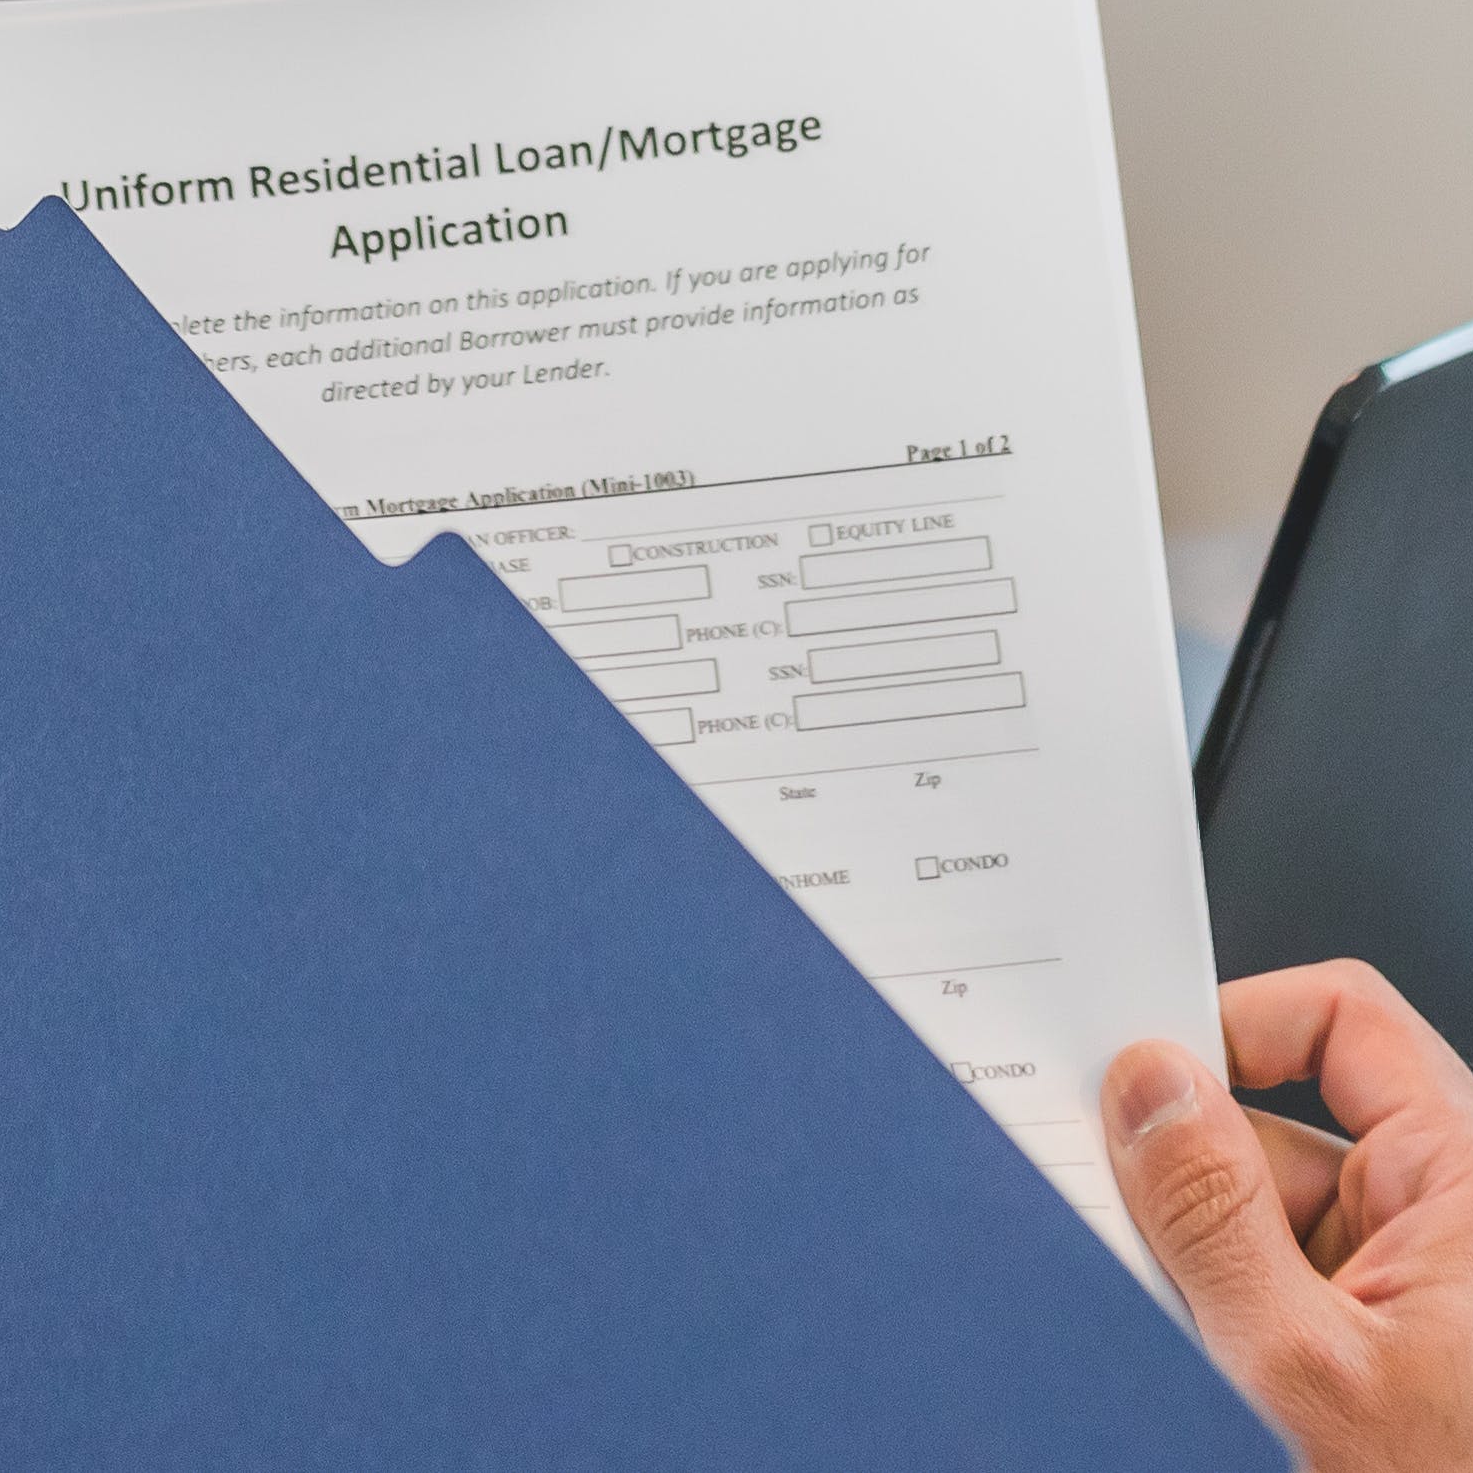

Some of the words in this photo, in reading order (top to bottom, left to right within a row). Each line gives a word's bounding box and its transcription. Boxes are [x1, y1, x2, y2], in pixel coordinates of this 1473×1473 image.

[61, 173, 234, 212] Uniform
[249, 143, 480, 198] Residential
[495, 114, 822, 175] Loan/Mortgage
[330, 207, 568, 263] Application
[171, 314, 225, 337] lete
[234, 309, 272, 332] the
[280, 294, 421, 332] information
[428, 294, 458, 316] on
[466, 285, 509, 311] this
[516, 275, 657, 314] application.
[666, 269, 688, 296] If
[688, 266, 732, 293] you
[739, 261, 777, 284] are
[785, 246, 888, 283] applying
[895, 242, 931, 271] for
[266, 344, 322, 369] each
[329, 332, 452, 365] additional
[459, 321, 569, 353] Borrower
[576, 314, 639, 340] must
[645, 304, 735, 337] provide
[742, 289, 886, 325] information
[893, 283, 921, 307] as
[320, 375, 420, 404] directed
[427, 372, 455, 398] by
[462, 367, 516, 394] your
[523, 357, 611, 386] Lender.
[906, 443, 952, 464] Page
[959, 439, 967, 457] 1
[974, 436, 994, 455] of
[999, 434, 1012, 454] 2
[366, 495, 458, 516] Mortgage
[466, 482, 575, 509] Application
[581, 469, 696, 499] (Mini-1003)
[837, 518, 905, 540] EQUITY
[911, 513, 956, 532] LINE
[632, 532, 779, 564] CONSTRUCTION
[757, 572, 797, 589] SSN:
[686, 623, 748, 643] PHONE
[752, 619, 784, 639] (C):
[768, 663, 808, 681] SSN:
[697, 715, 760, 735] PHONE
[779, 784, 816, 801] State
[914, 770, 942, 790] Zip
[941, 852, 1009, 874] CONDO
[941, 979, 968, 997] Zip
[972, 1061, 1036, 1082] CONDO
